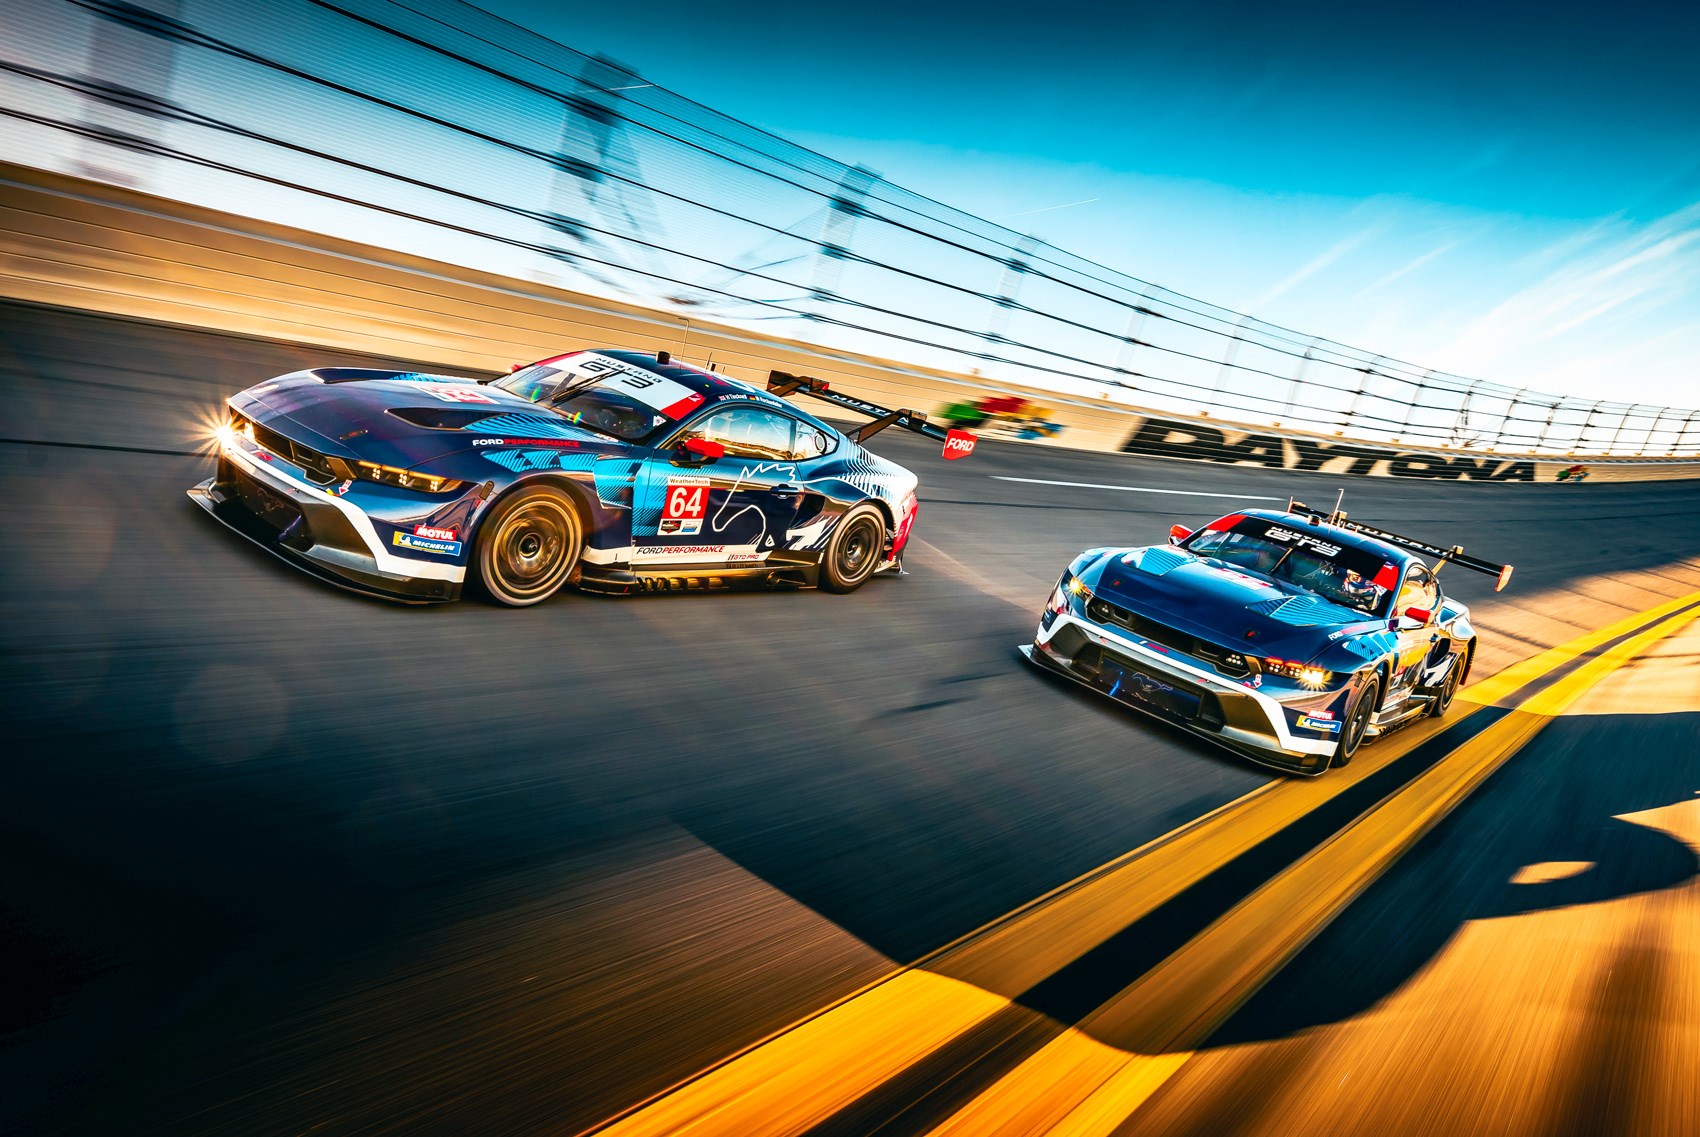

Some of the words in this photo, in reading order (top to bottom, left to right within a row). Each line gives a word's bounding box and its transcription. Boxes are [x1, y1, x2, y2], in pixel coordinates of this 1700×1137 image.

[579, 361, 654, 389] GT3
[595, 357, 663, 384] MUSTANG
[946, 437, 975, 452] FORD
[1122, 418, 1535, 482] DAYTONA
[669, 486, 703, 518] 64
[412, 539, 456, 551] MICHELIN
[415, 526, 455, 541] MOTUL
[1264, 529, 1339, 557] GT3
[1270, 526, 1343, 552] MUSTANG
